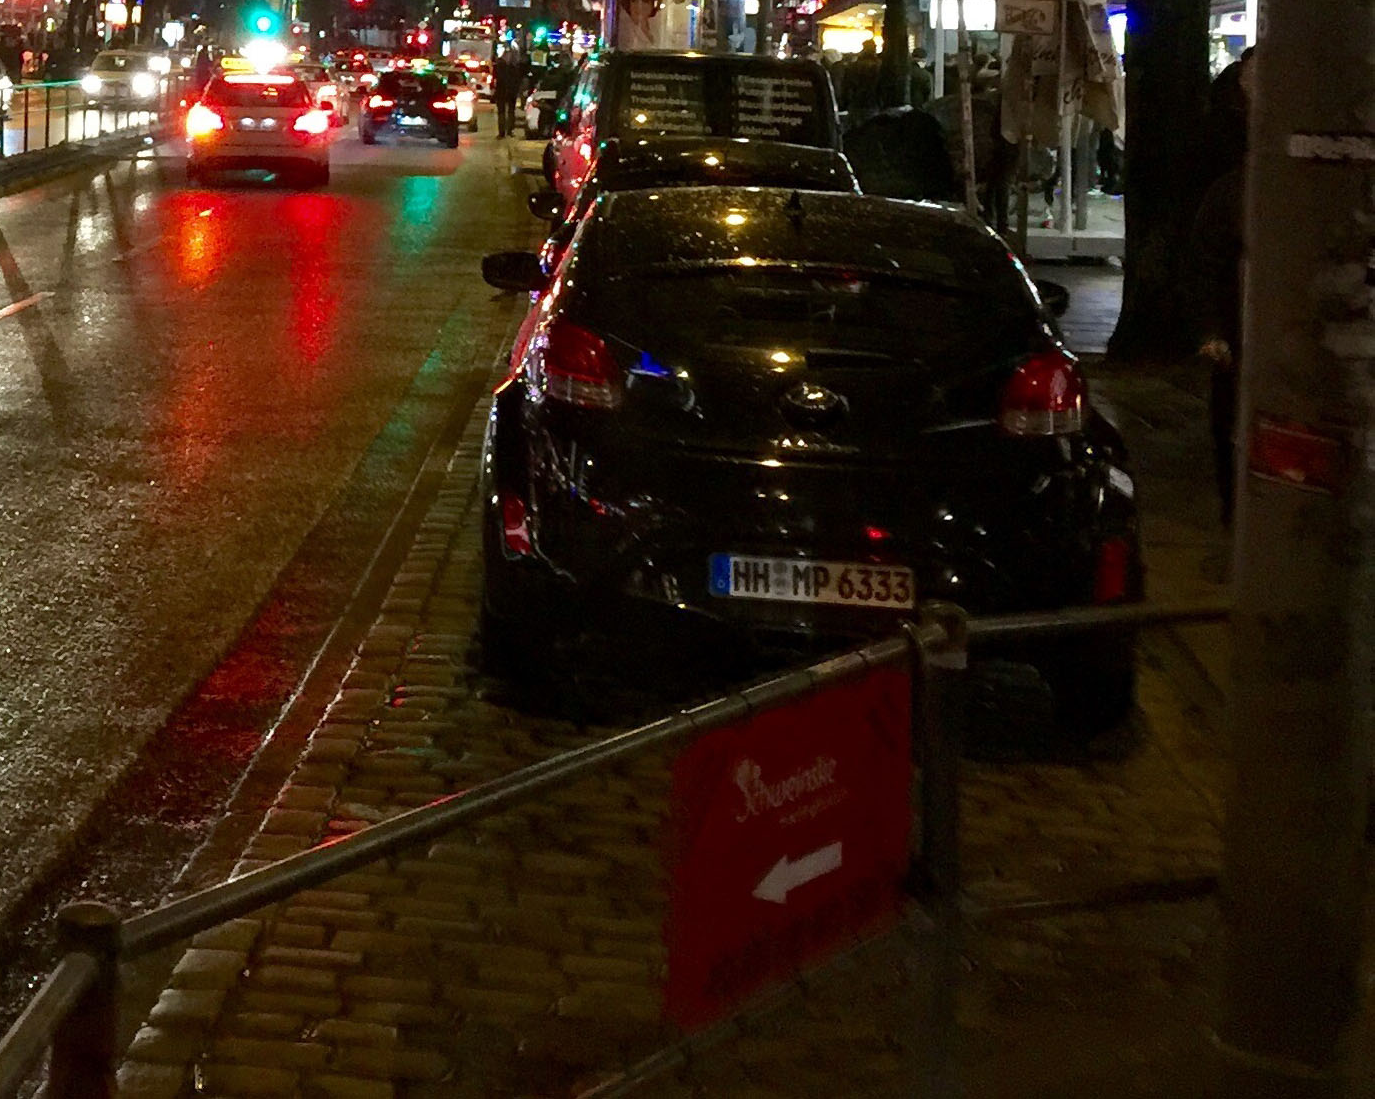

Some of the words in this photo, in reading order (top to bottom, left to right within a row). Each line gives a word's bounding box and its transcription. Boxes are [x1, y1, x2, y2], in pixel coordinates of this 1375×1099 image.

[732, 560, 771, 593] HH
[791, 564, 830, 598] MP
[837, 567, 911, 603] 6333
